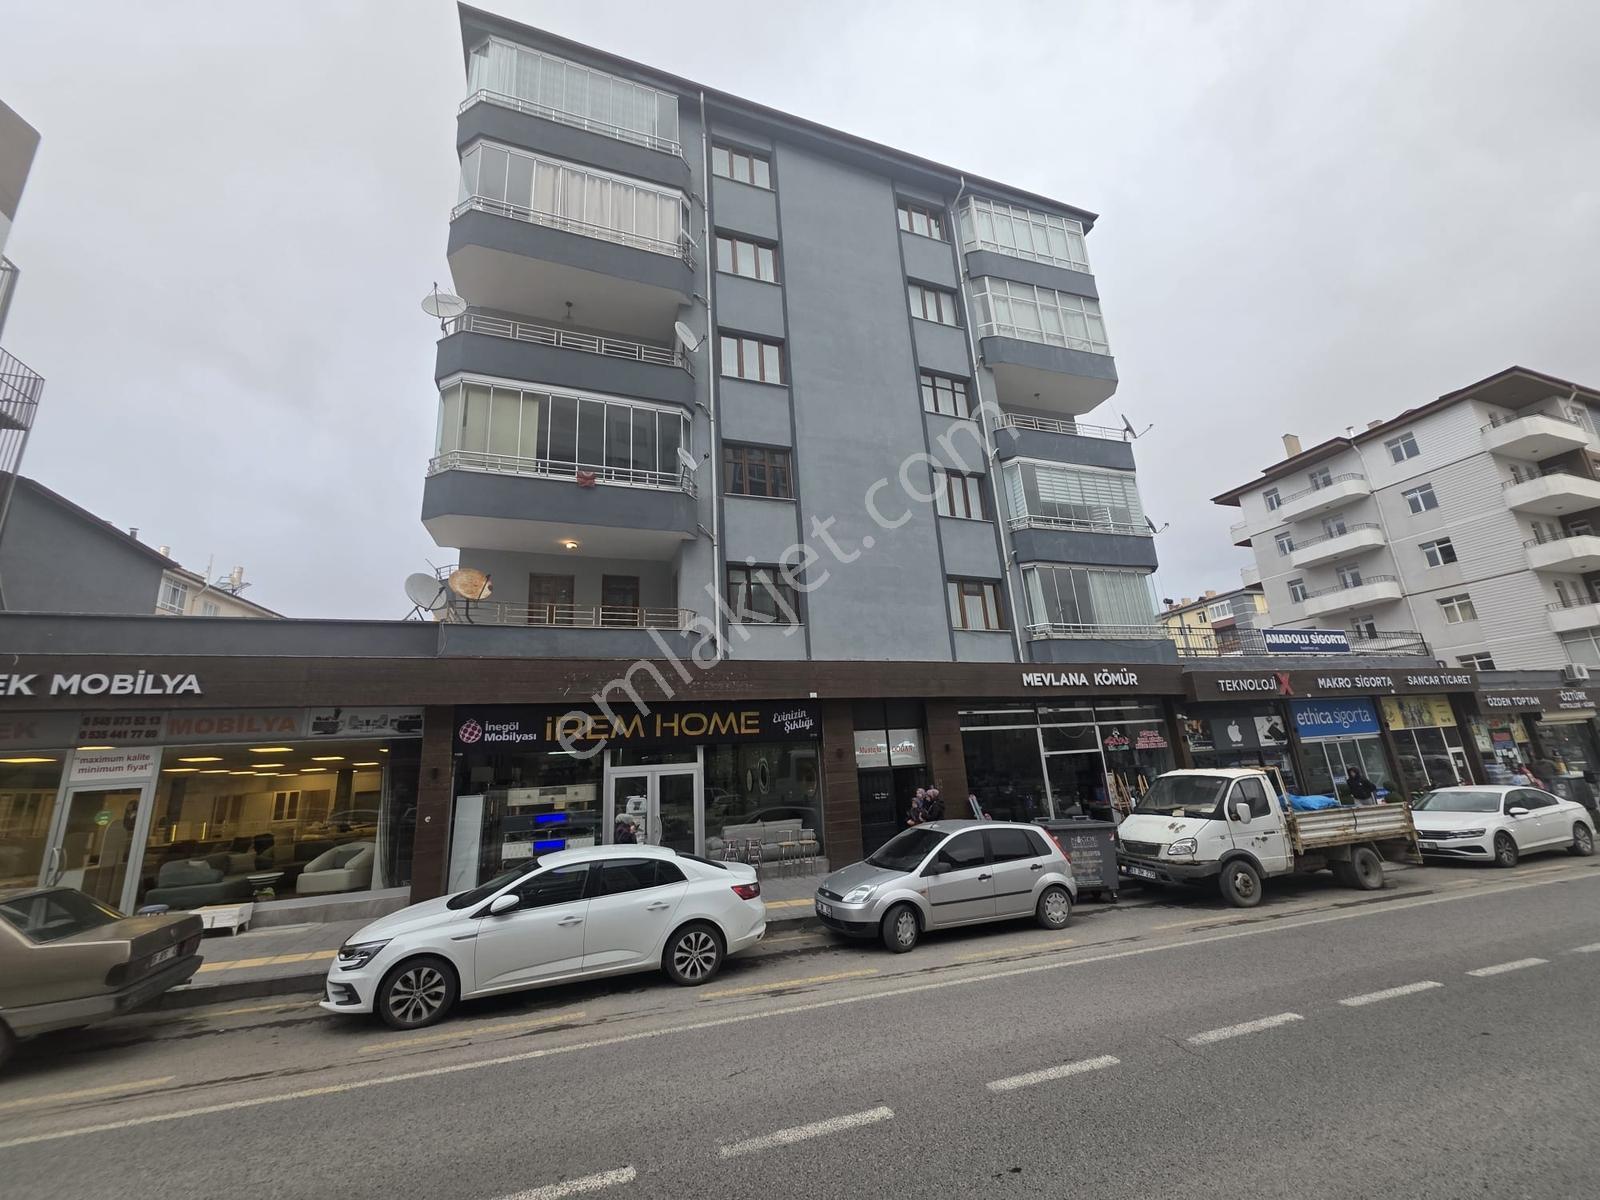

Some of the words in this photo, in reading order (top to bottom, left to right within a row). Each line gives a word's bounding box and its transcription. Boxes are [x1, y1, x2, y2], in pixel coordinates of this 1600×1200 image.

[1266, 634, 1309, 644] ANADOLU
[1311, 632, 1347, 644] SİGORTA
[50, 670, 202, 695] MOBİLYA
[1022, 673, 1089, 686] MEVLANA
[1094, 668, 1138, 686] KÖMÜR
[1318, 677, 1351, 688] MAKRO
[1356, 675, 1394, 687] SİGORTA
[1407, 675, 1440, 685] SANCAR
[1441, 673, 1472, 684] TİCARET
[1487, 695, 1512, 707] ÖZDEN
[1513, 697, 1541, 706] TOPTAN
[1560, 690, 1588, 701] ÖZTÜRK
[772, 709, 807, 724] Evinizin
[1296, 707, 1333, 726] ethica
[1333, 708, 1371, 728] sigorta
[169, 713, 296, 736] MOBİLYA
[485, 721, 519, 733] İnegöl
[655, 711, 760, 737] HOME
[784, 717, 814, 734] Şıklığı
[130, 730, 144, 738] 77
[484, 731, 537, 743] Mobilyası
[126, 753, 150, 762] kalite
[78, 765, 126, 775] minimum
